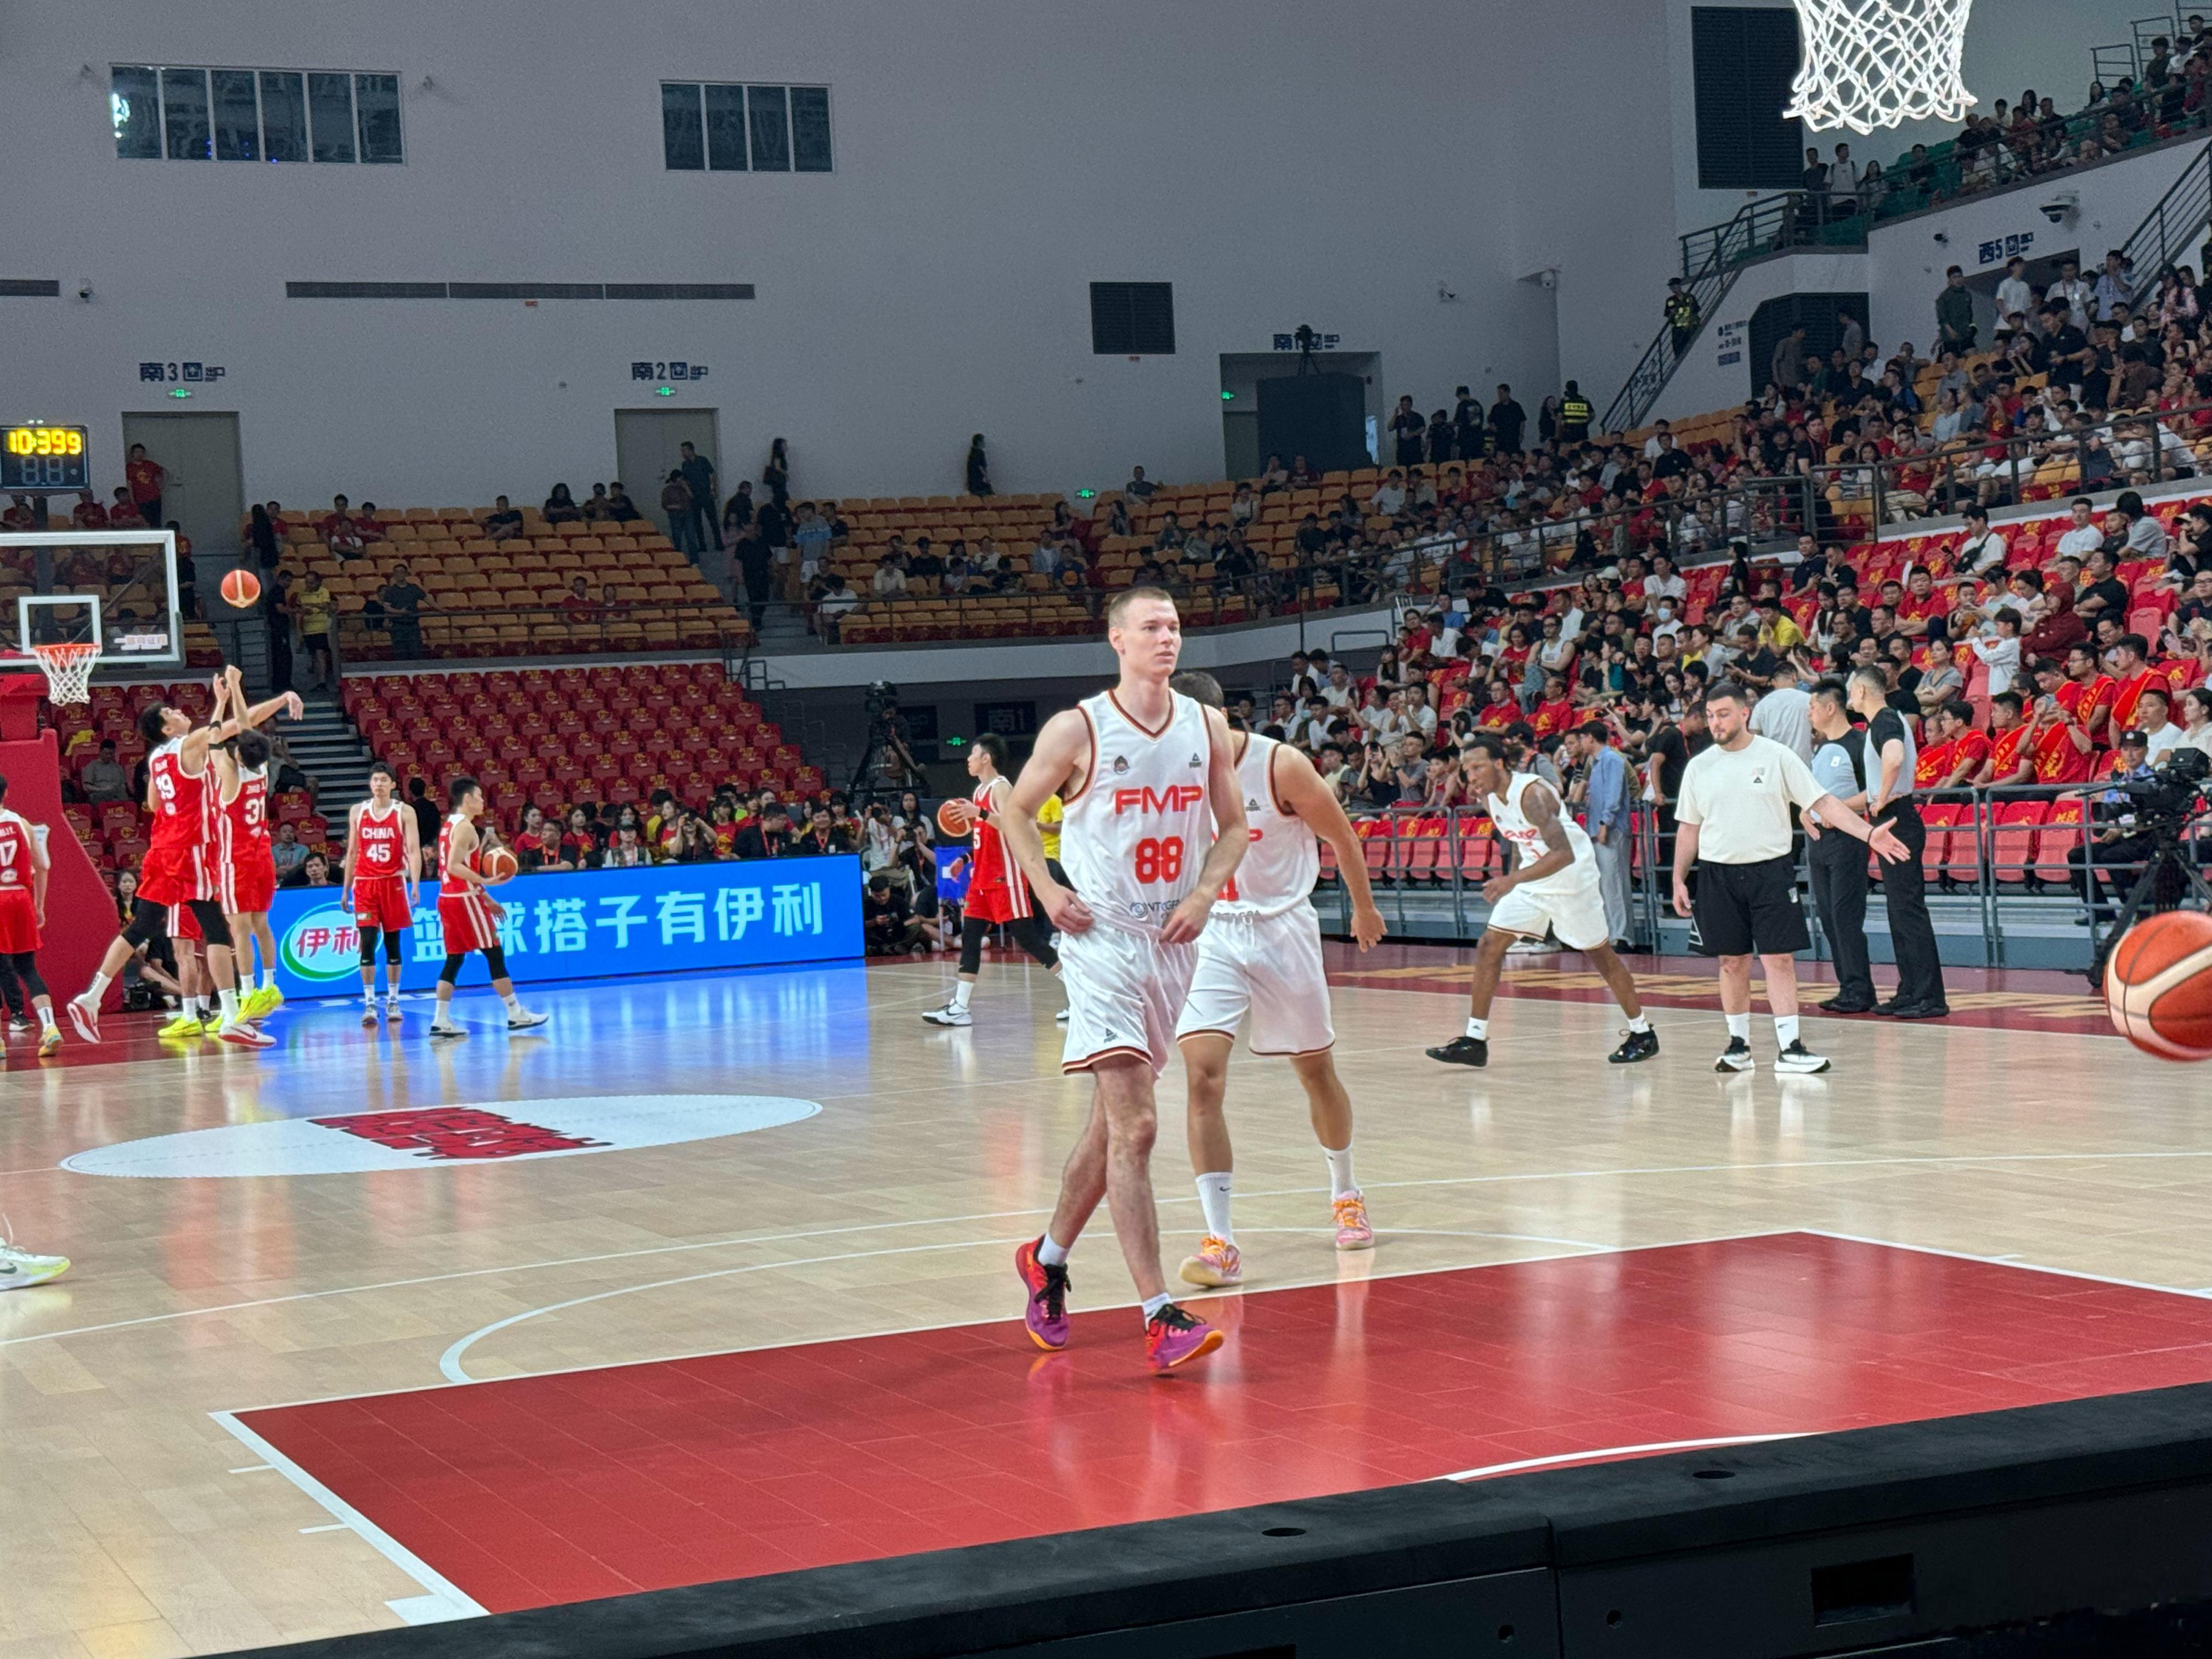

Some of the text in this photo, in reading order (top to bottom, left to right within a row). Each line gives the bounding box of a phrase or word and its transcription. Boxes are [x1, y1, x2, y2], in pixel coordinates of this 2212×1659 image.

[139, 362, 178, 381] 南3
[632, 363, 667, 380] 南2
[1115, 785, 1203, 816] FMP
[362, 827, 396, 839] CHINA
[366, 843, 391, 862] 45
[1135, 836, 1184, 884] 88
